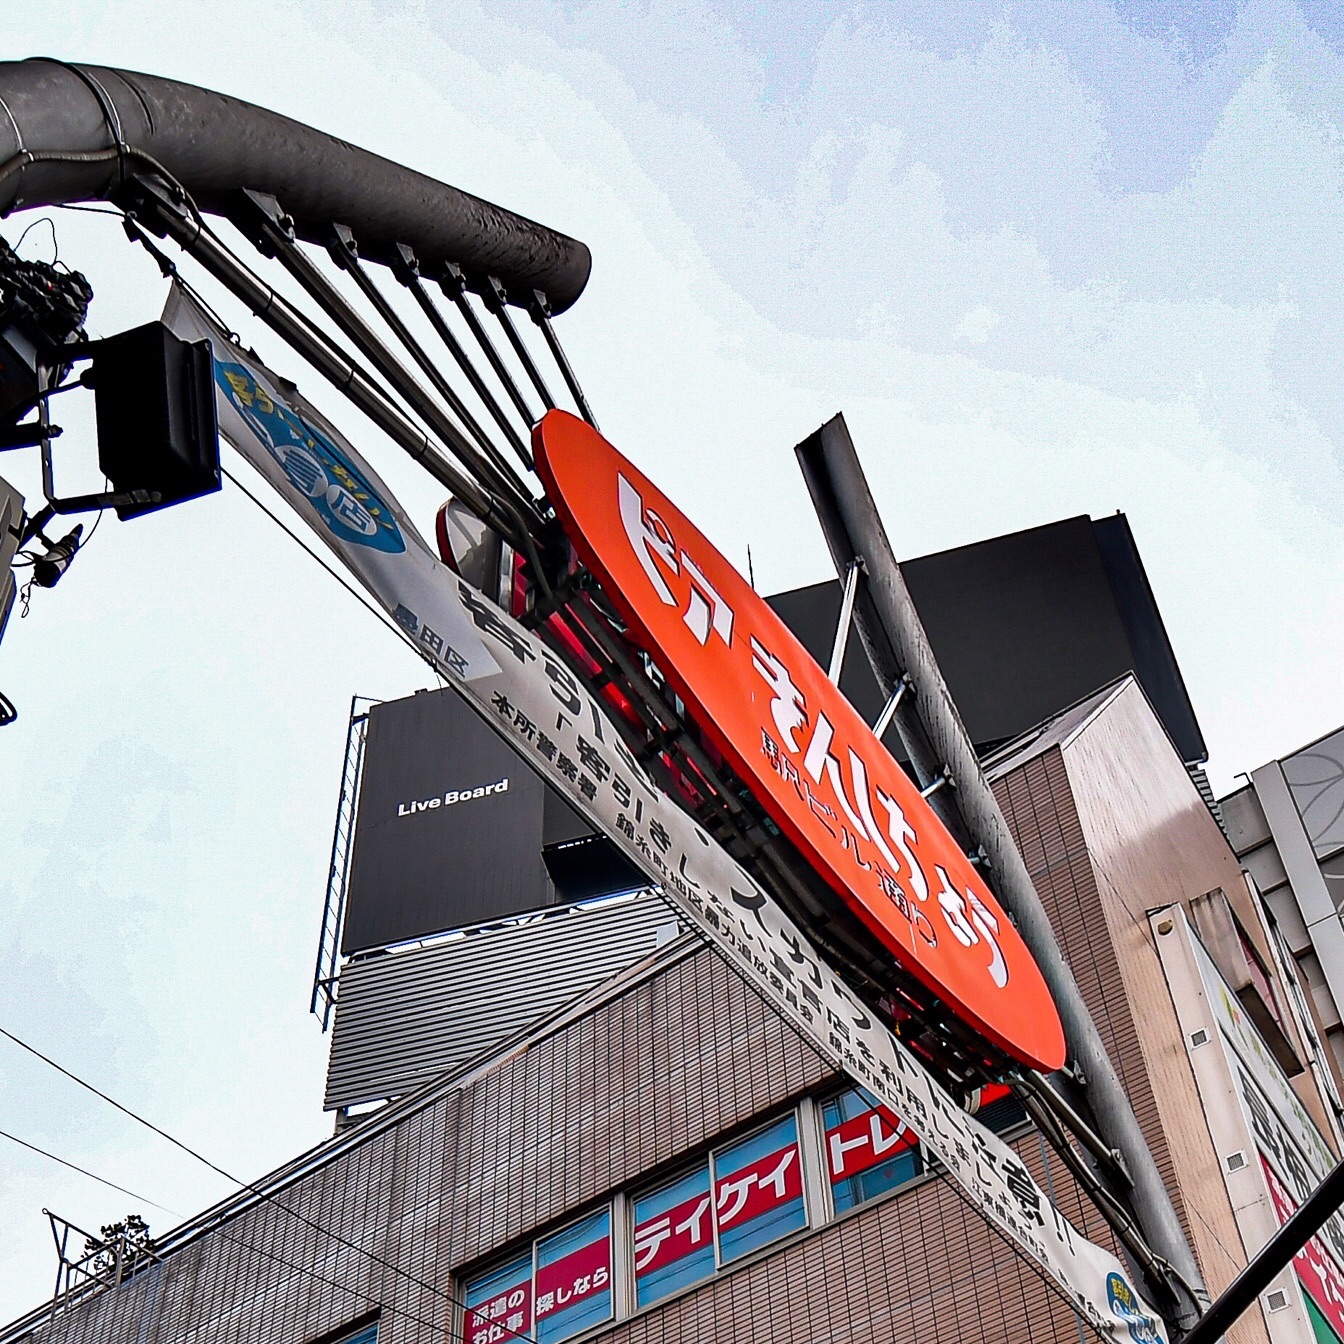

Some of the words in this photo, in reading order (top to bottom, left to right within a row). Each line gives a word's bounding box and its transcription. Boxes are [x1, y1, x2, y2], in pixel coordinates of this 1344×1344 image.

[394, 602, 470, 680] 墨田区
[397, 797, 442, 817] Live
[444, 778, 509, 805] Board
[759, 727, 938, 948] 駅ビル通り
[490, 688, 598, 803] 本所警察署
[615, 812, 816, 1025] 錦糸町地区暴力追放委員会
[827, 1031, 963, 1173] 錦糸町南口を考える会
[471, 1288, 525, 1328] 派遣の
[536, 1266, 610, 1315] 探しなら
